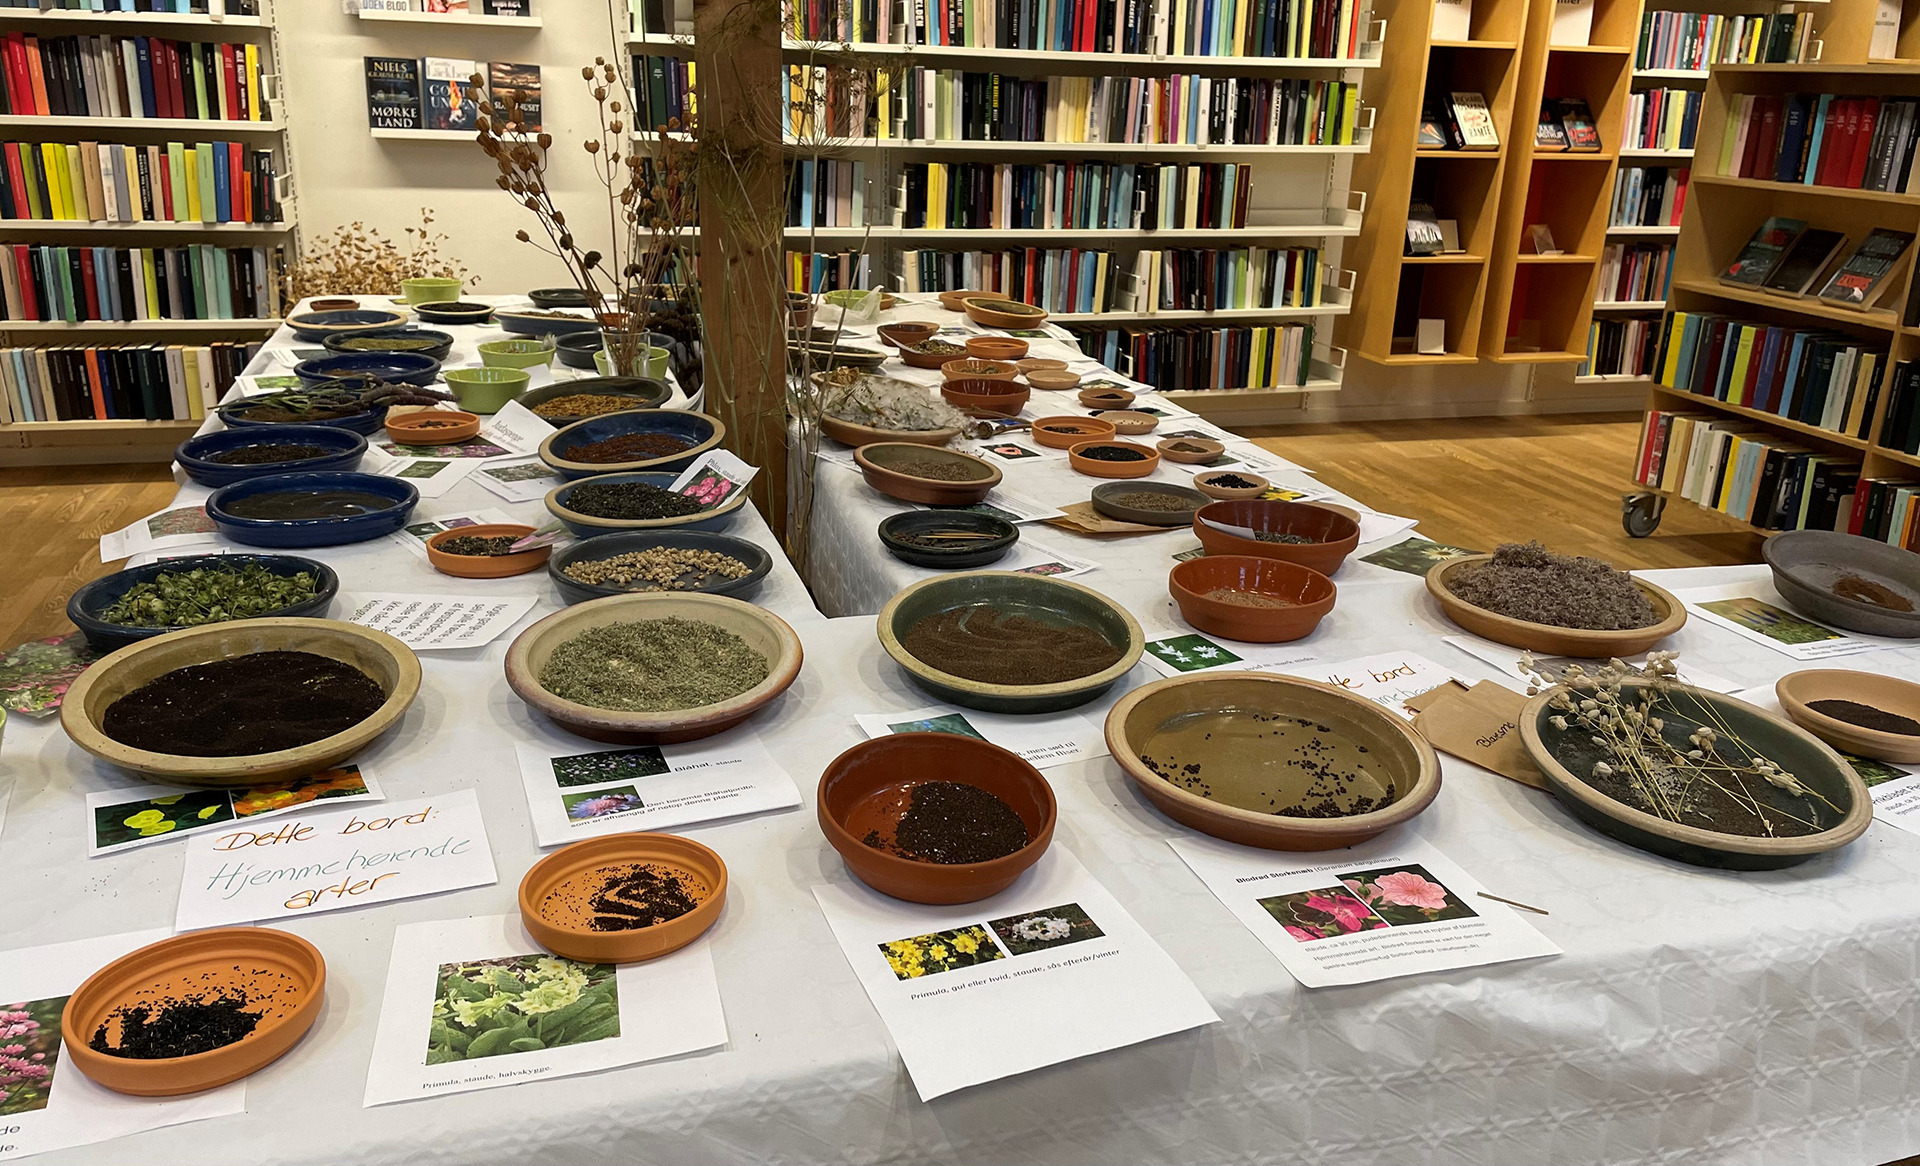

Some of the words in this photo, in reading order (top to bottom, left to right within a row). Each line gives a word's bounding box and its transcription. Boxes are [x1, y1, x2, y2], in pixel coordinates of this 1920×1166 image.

[374, 62, 407, 72] NIELS
[371, 106, 417, 119] MØRKE
[377, 117, 413, 128] LAND
[674, 761, 712, 772] Blåhat,
[1027, 753, 1055, 761] ellem
[666, 794, 702, 805] berømte
[570, 820, 590, 828] som
[604, 809, 646, 823] afhængig
[658, 802, 683, 812] netop
[684, 797, 711, 806] denne
[713, 792, 742, 803] plante.
[212, 822, 318, 851] Dette
[207, 837, 471, 900] Hjemmehørende
[284, 871, 400, 910] arter
[910, 986, 949, 1001] Primula,
[951, 982, 966, 994] gul
[967, 977, 988, 988] eller
[988, 971, 1011, 984] hvid,
[1012, 965, 1046, 978] staude,
[1063, 947, 1121, 968] efterår/vinter
[421, 1077, 461, 1090] Primula,
[464, 1072, 496, 1084] staude,
[499, 1064, 553, 1081] halvskygge.
